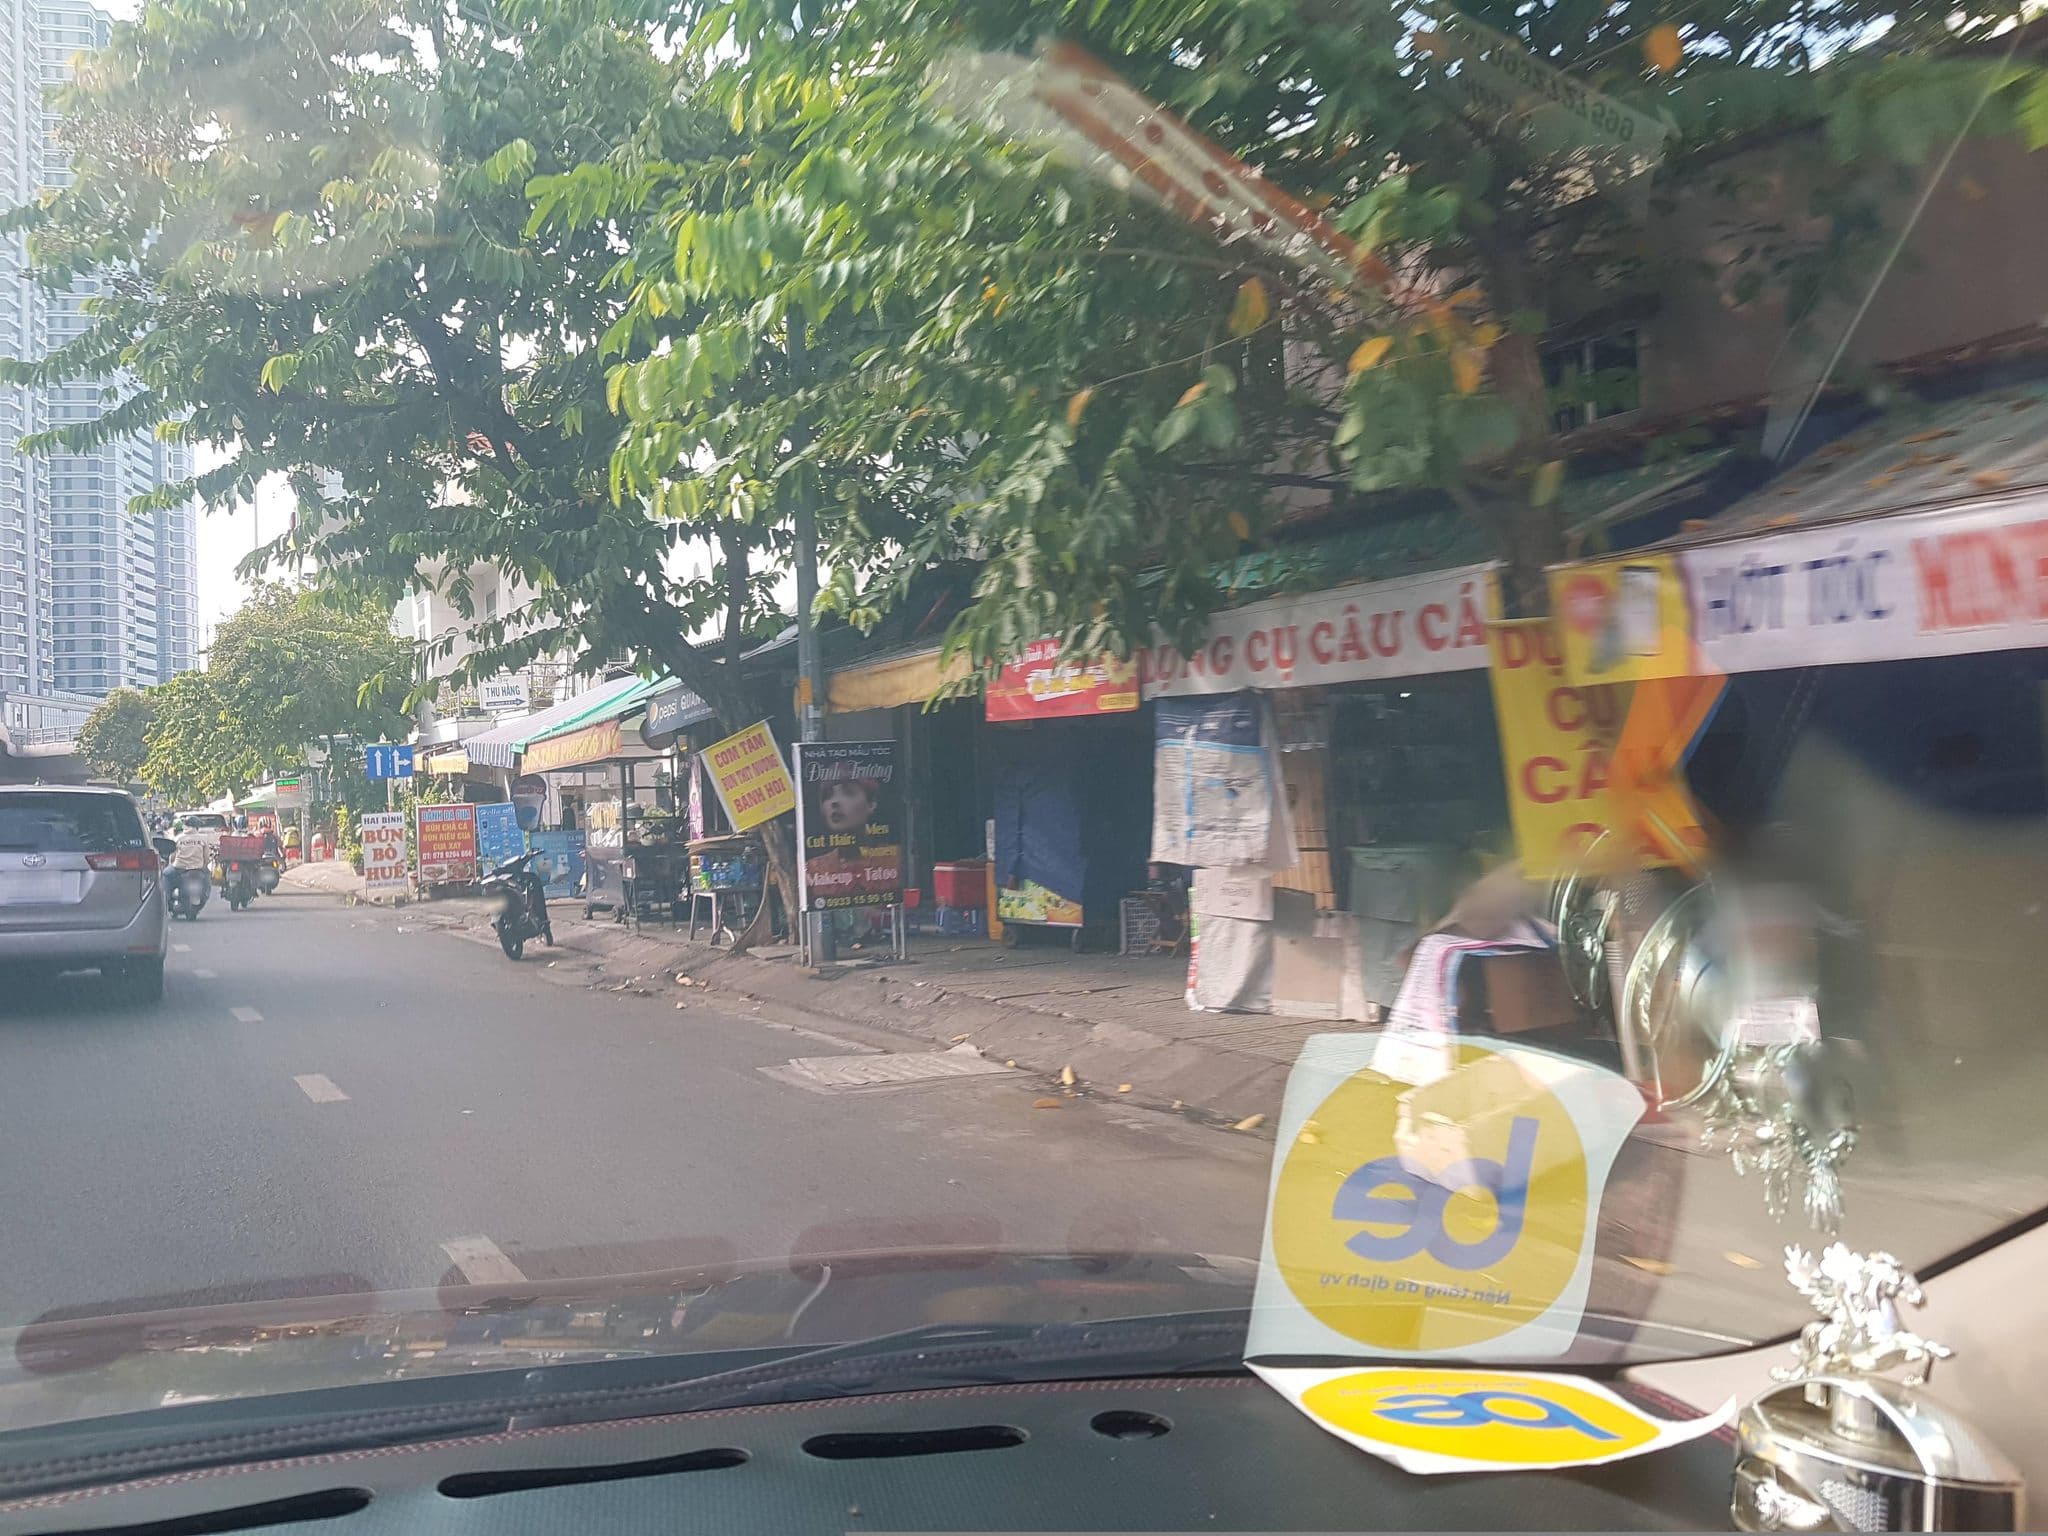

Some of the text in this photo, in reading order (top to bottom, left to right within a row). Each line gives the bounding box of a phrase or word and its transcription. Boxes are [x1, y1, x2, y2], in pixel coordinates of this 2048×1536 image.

[1248, 624, 1298, 682] CỤ
[1309, 604, 1402, 667] CÂU
[1416, 581, 1488, 652] CÁ
[485, 687, 500, 698] THU
[658, 699, 678, 722] pepsi
[363, 815, 403, 825] HAI BÌNH
[865, 823, 890, 836] Men
[363, 825, 404, 844] BÚN
[806, 834, 856, 849] Cut Hair:
[372, 843, 397, 862] BÒ
[365, 859, 406, 881] HUẾ
